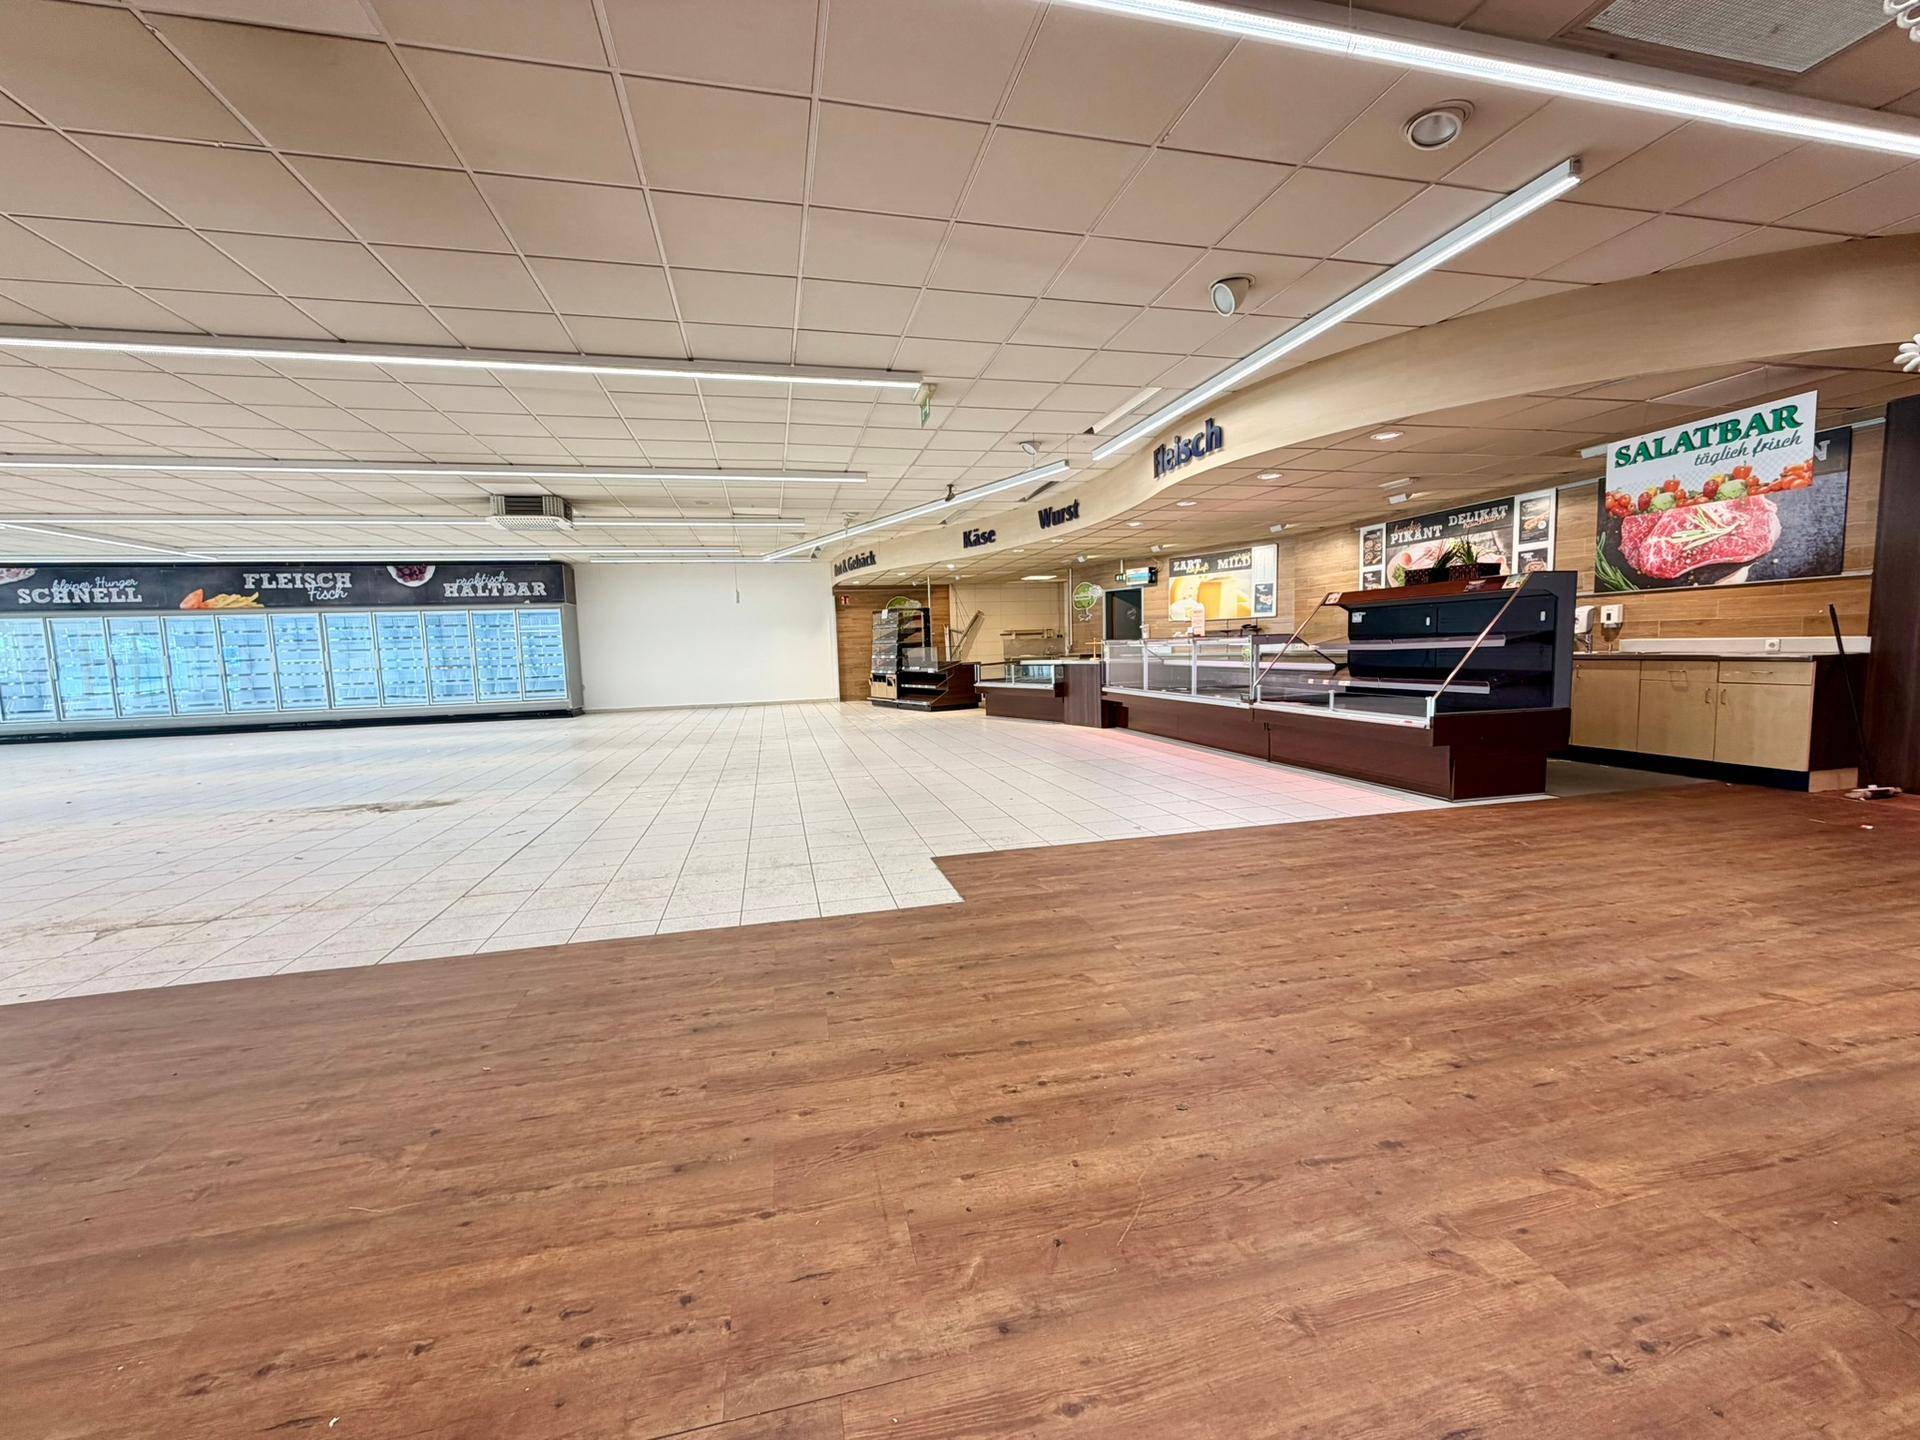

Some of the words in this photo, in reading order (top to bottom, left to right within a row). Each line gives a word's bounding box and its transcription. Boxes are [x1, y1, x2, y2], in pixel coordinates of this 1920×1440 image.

[1614, 404, 1804, 468] SALATBAR
[1153, 417, 1223, 478] Fleisch
[1694, 441, 1749, 467] täglich
[1752, 429, 1803, 457] frisch
[1038, 498, 1080, 529] Wurst
[1448, 505, 1508, 527] DELIKAT
[963, 528, 996, 549] Käse
[1390, 524, 1443, 545] PIKANT
[847, 550, 877, 571] Gebäck
[1173, 558, 1202, 571] ZART
[95, 576, 138, 590] Hunger
[243, 572, 352, 589] FLEISCH
[456, 570, 508, 586] praktisch
[17, 587, 143, 604] SCHNELL
[308, 583, 348, 602] Fisch
[443, 581, 547, 597] HALTBAR
